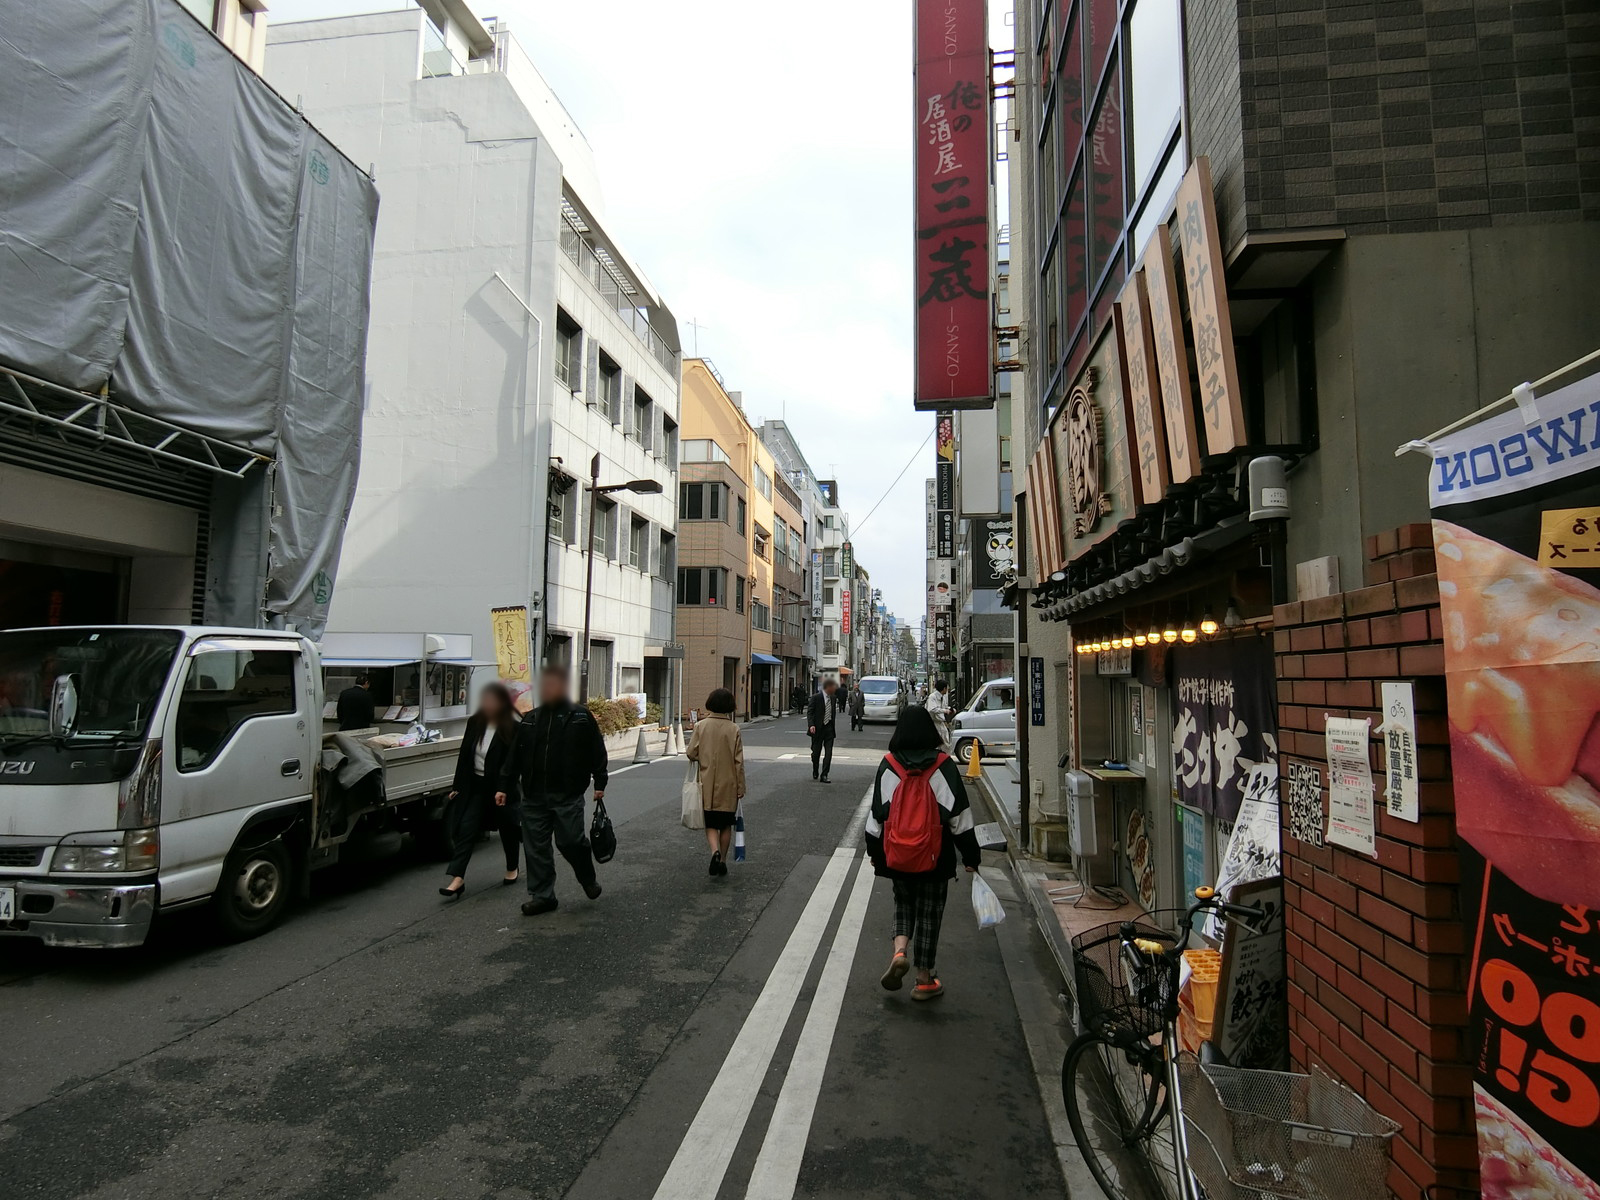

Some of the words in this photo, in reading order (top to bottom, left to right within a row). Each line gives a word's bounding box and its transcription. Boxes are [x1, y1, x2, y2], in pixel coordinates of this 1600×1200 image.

[944, 8, 957, 56] SANZO
[944, 80, 983, 132] 俺の
[922, 94, 963, 175] 居酒屋
[1183, 201, 1225, 430] 肉汁餃子
[946, 325, 960, 377] SANZO
[1126, 302, 1156, 485] 手羽餃子
[1033, 713, 1043, 722] 17
[1388, 729, 1402, 812] 放置厳禁
[1402, 732, 1413, 780] 自転車
